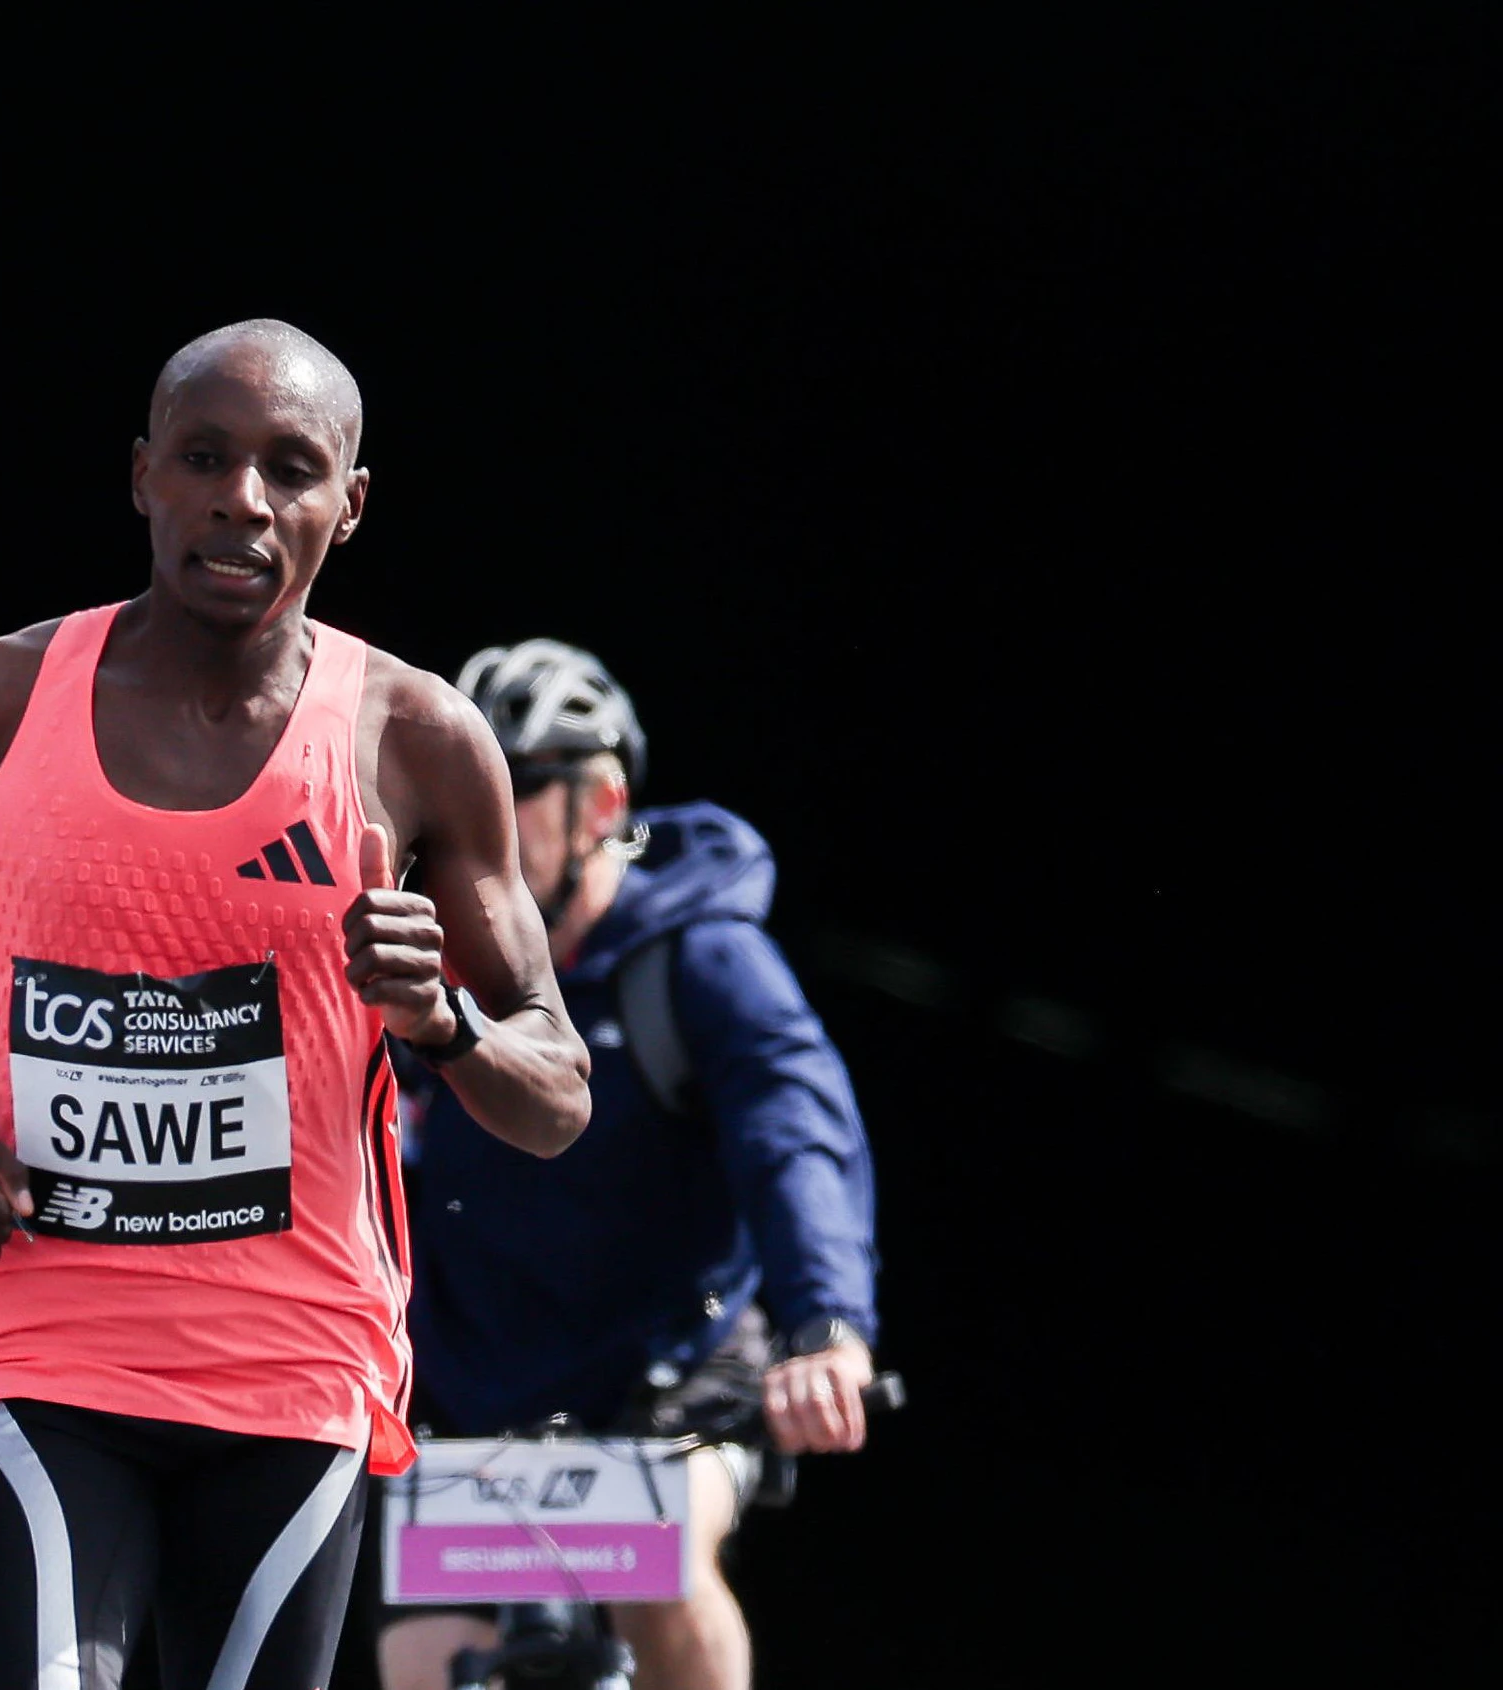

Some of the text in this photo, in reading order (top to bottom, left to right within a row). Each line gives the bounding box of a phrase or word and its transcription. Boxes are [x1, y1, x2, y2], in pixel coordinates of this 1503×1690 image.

[25, 976, 115, 1050] tcs
[122, 990, 184, 1009] TATA
[122, 1002, 262, 1031] CONSULTANCY
[122, 1035, 217, 1054] SERVICES
[49, 1093, 247, 1166] SAWE
[115, 1205, 265, 1233] new balance
